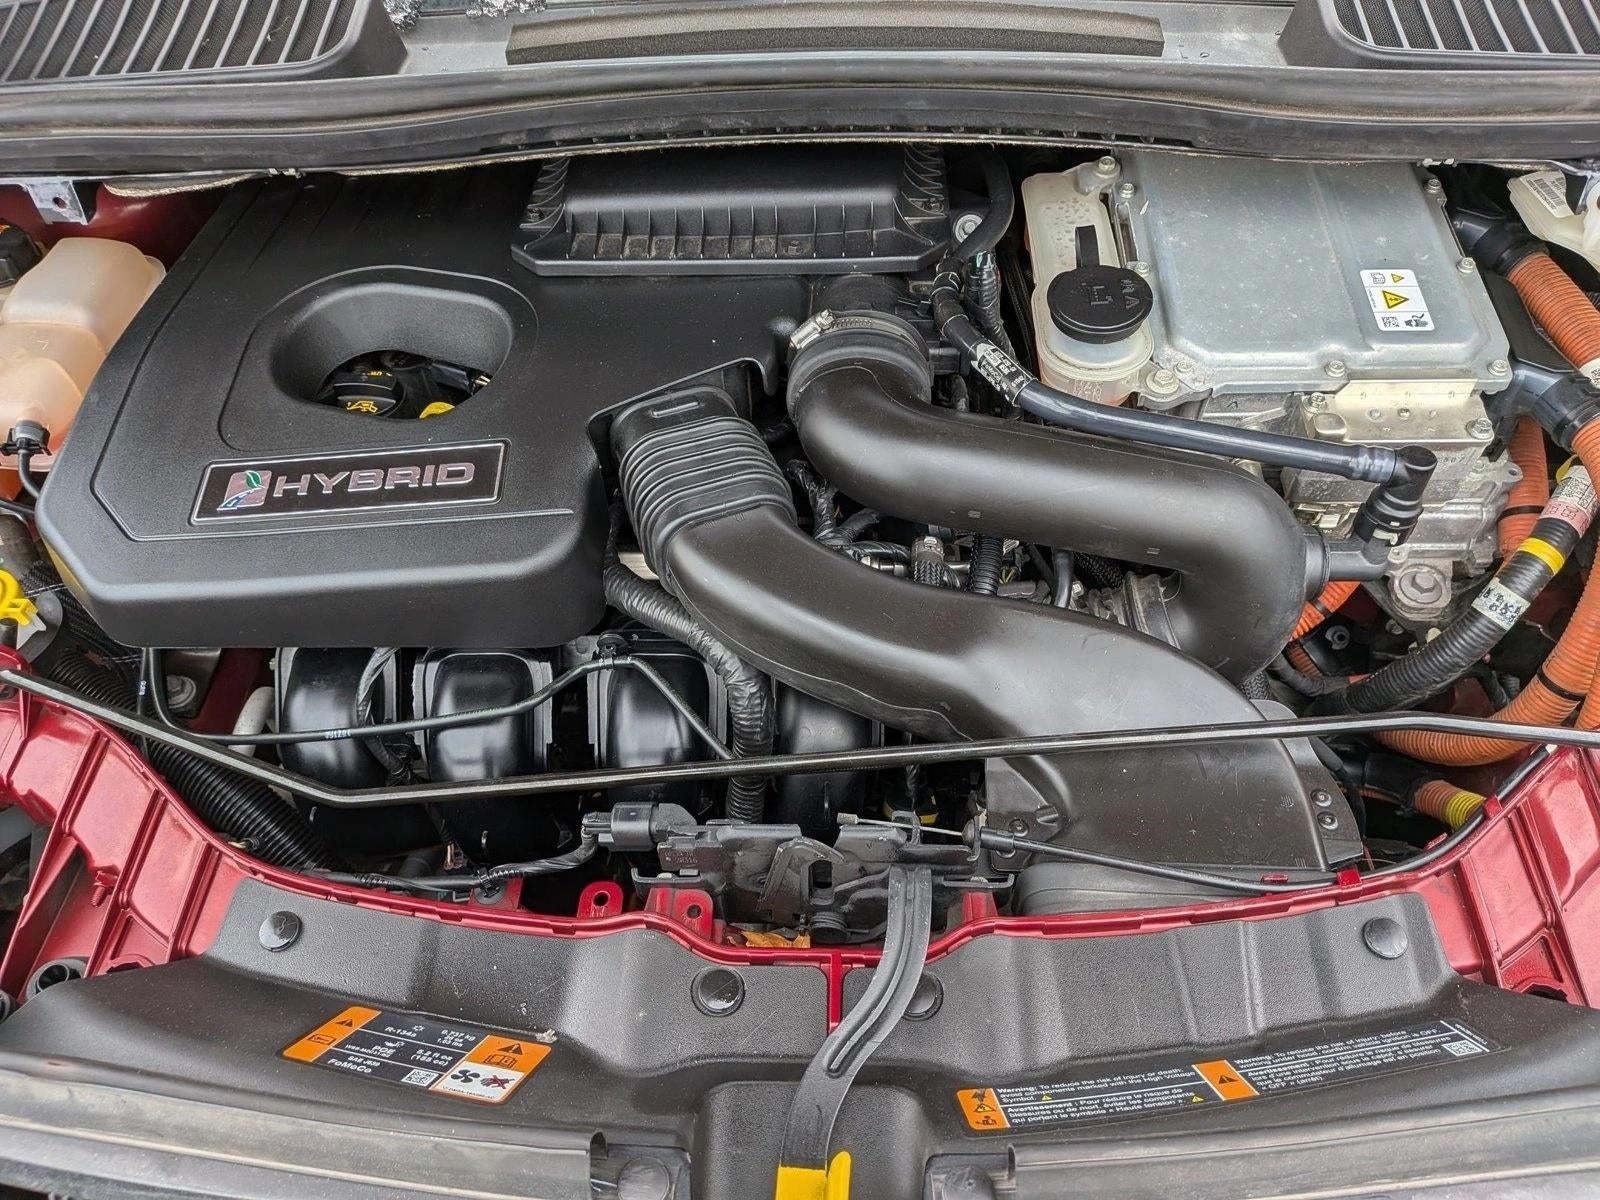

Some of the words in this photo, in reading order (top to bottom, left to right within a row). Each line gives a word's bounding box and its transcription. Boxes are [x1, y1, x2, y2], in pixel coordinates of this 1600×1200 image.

[273, 462, 475, 497] HYBRID
[384, 1026, 417, 1038] R-134a
[1287, 1047, 1314, 1055] reduce
[328, 1058, 372, 1073] FoMoCo
[1248, 1062, 1309, 1077] Avertissement
[1292, 1063, 1340, 1074] intervention
[1284, 1068, 1336, 1081] commutateur
[997, 1085, 1037, 1094] Warning:
[1051, 1081, 1080, 1089] reduce
[1024, 1086, 1075, 1096] components
[1077, 1082, 1109, 1090] marked
[1164, 1071, 1196, 1079] Voltage
[1268, 1081, 1287, 1089] OFF
[1007, 1101, 1073, 1113] Avertissement
[1144, 1090, 1170, 1098] risque
[1009, 1109, 1051, 1118] blessures
[1027, 1114, 1059, 1123] portent
[1070, 1109, 1107, 1118] symbole
[1115, 1104, 1142, 1112] Haute
[1144, 1100, 1176, 1108] tension
